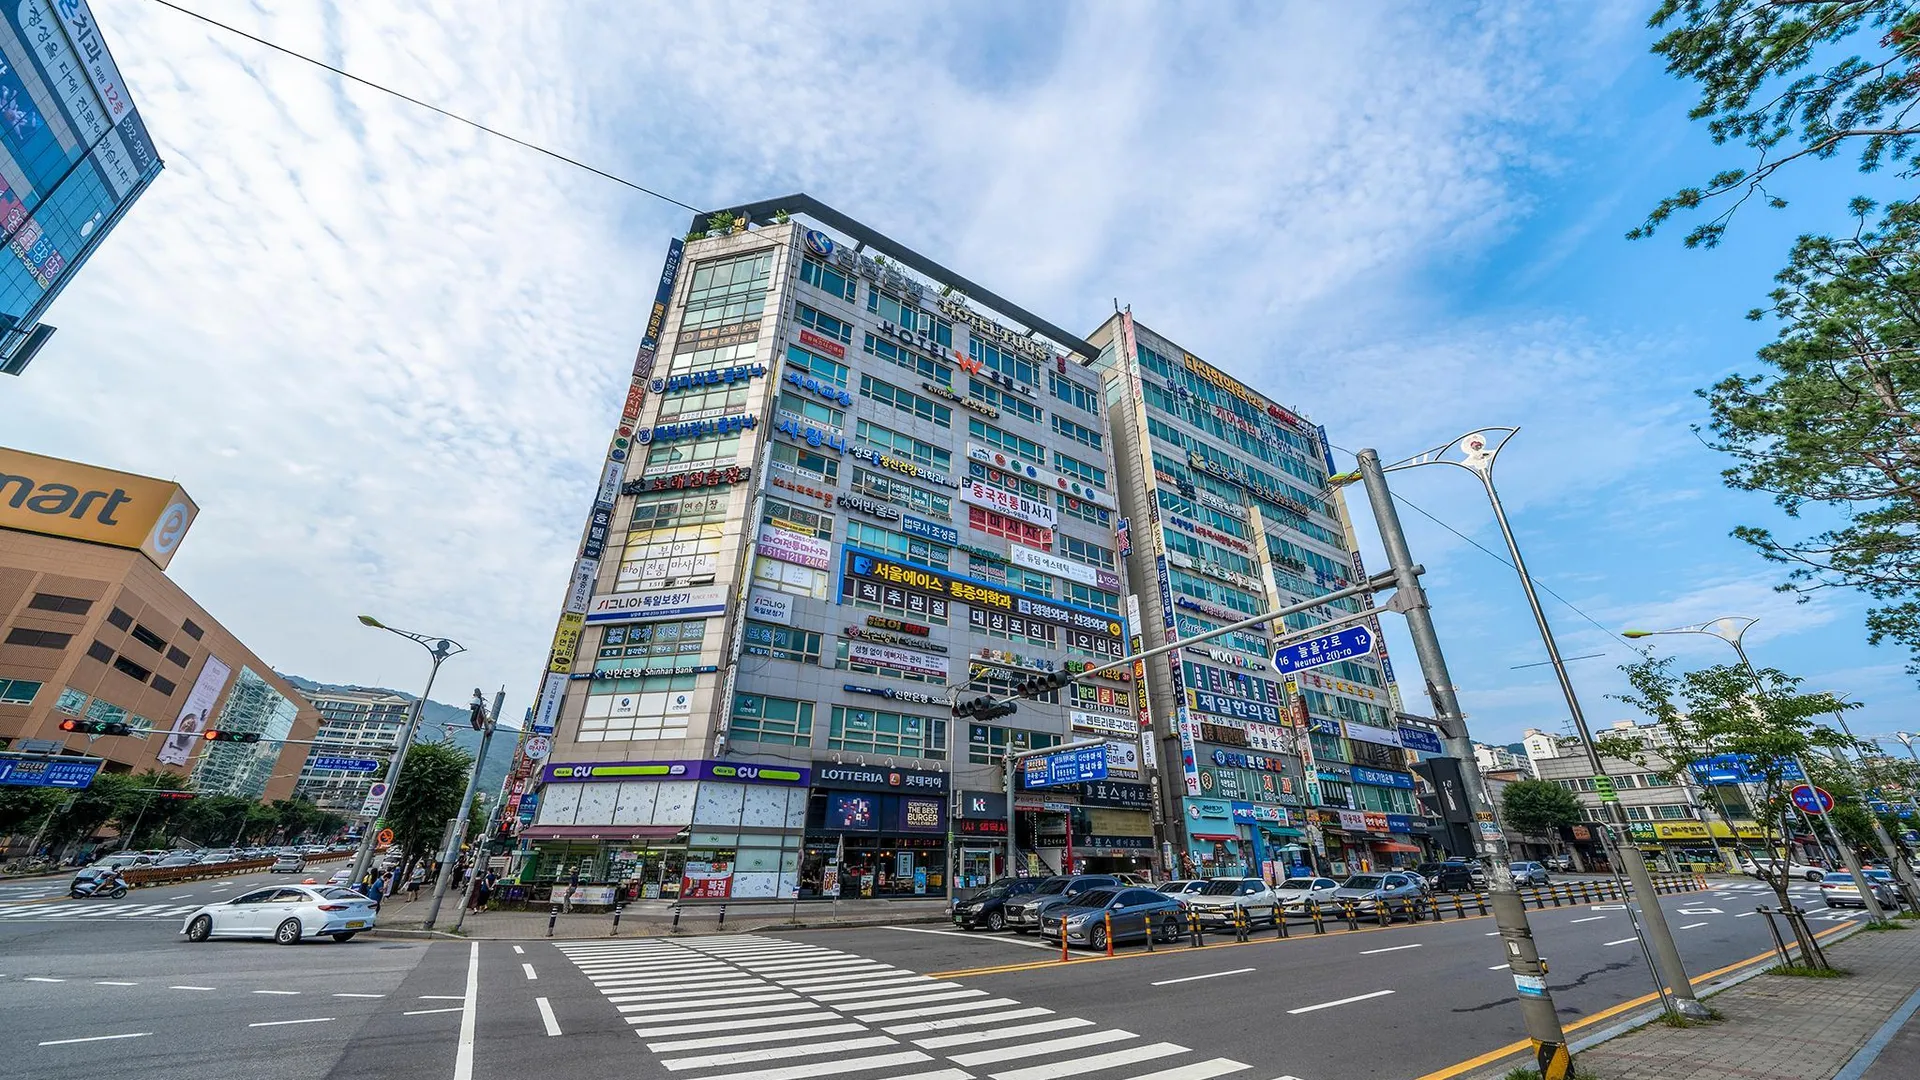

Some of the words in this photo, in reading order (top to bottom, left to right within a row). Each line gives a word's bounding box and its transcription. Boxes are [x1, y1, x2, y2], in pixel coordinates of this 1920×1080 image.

[59, 61, 78, 95] 다해
[103, 82, 122, 116] 12층
[122, 117, 151, 168] 592-9075
[878, 319, 950, 363] HOTEL
[955, 350, 984, 376] W
[789, 371, 852, 407] 치아교정
[780, 418, 847, 457] 사랑니
[653, 467, 741, 492] 노래연습장
[879, 454, 945, 485] 정신건강의학과
[850, 496, 899, 520] 어반옴므
[591, 512, 608, 541] 호텔
[904, 518, 930, 535] 법무사
[874, 562, 944, 593] 서울에이스
[949, 581, 1012, 610] 통증의학과
[862, 582, 946, 616] 척추관절
[972, 608, 1042, 639] 대상포진
[869, 646, 882, 657] 없이
[1077, 634, 1122, 657] 오십견
[1208, 648, 1233, 664] WOO
[1279, 655, 1290, 666] 16
[1294, 654, 1324, 669] Neureul
[1354, 634, 1367, 646] 12
[1297, 635, 1342, 659] 늘을2로
[604, 668, 642, 679] 신한은행
[645, 668, 674, 676] Shinhan
[675, 666, 694, 675] Bank
[894, 690, 928, 704] 신한은행
[1079, 684, 1097, 700] 발리
[1136, 678, 1147, 709] 가요장
[1139, 710, 1149, 722] 3F
[1199, 692, 1279, 723] 제일한의원
[1249, 722, 1267, 738] 허리
[573, 765, 592, 778] CU
[737, 765, 758, 779] CU
[821, 768, 884, 784] LOTTERIA
[905, 775, 943, 788] 롯데리아
[1096, 784, 1120, 800] 포스
[908, 806, 920, 814] THE
[921, 806, 939, 815] BEST
[973, 797, 986, 812] kt
[907, 813, 939, 823] BURGER
[707, 879, 727, 891] 복권
